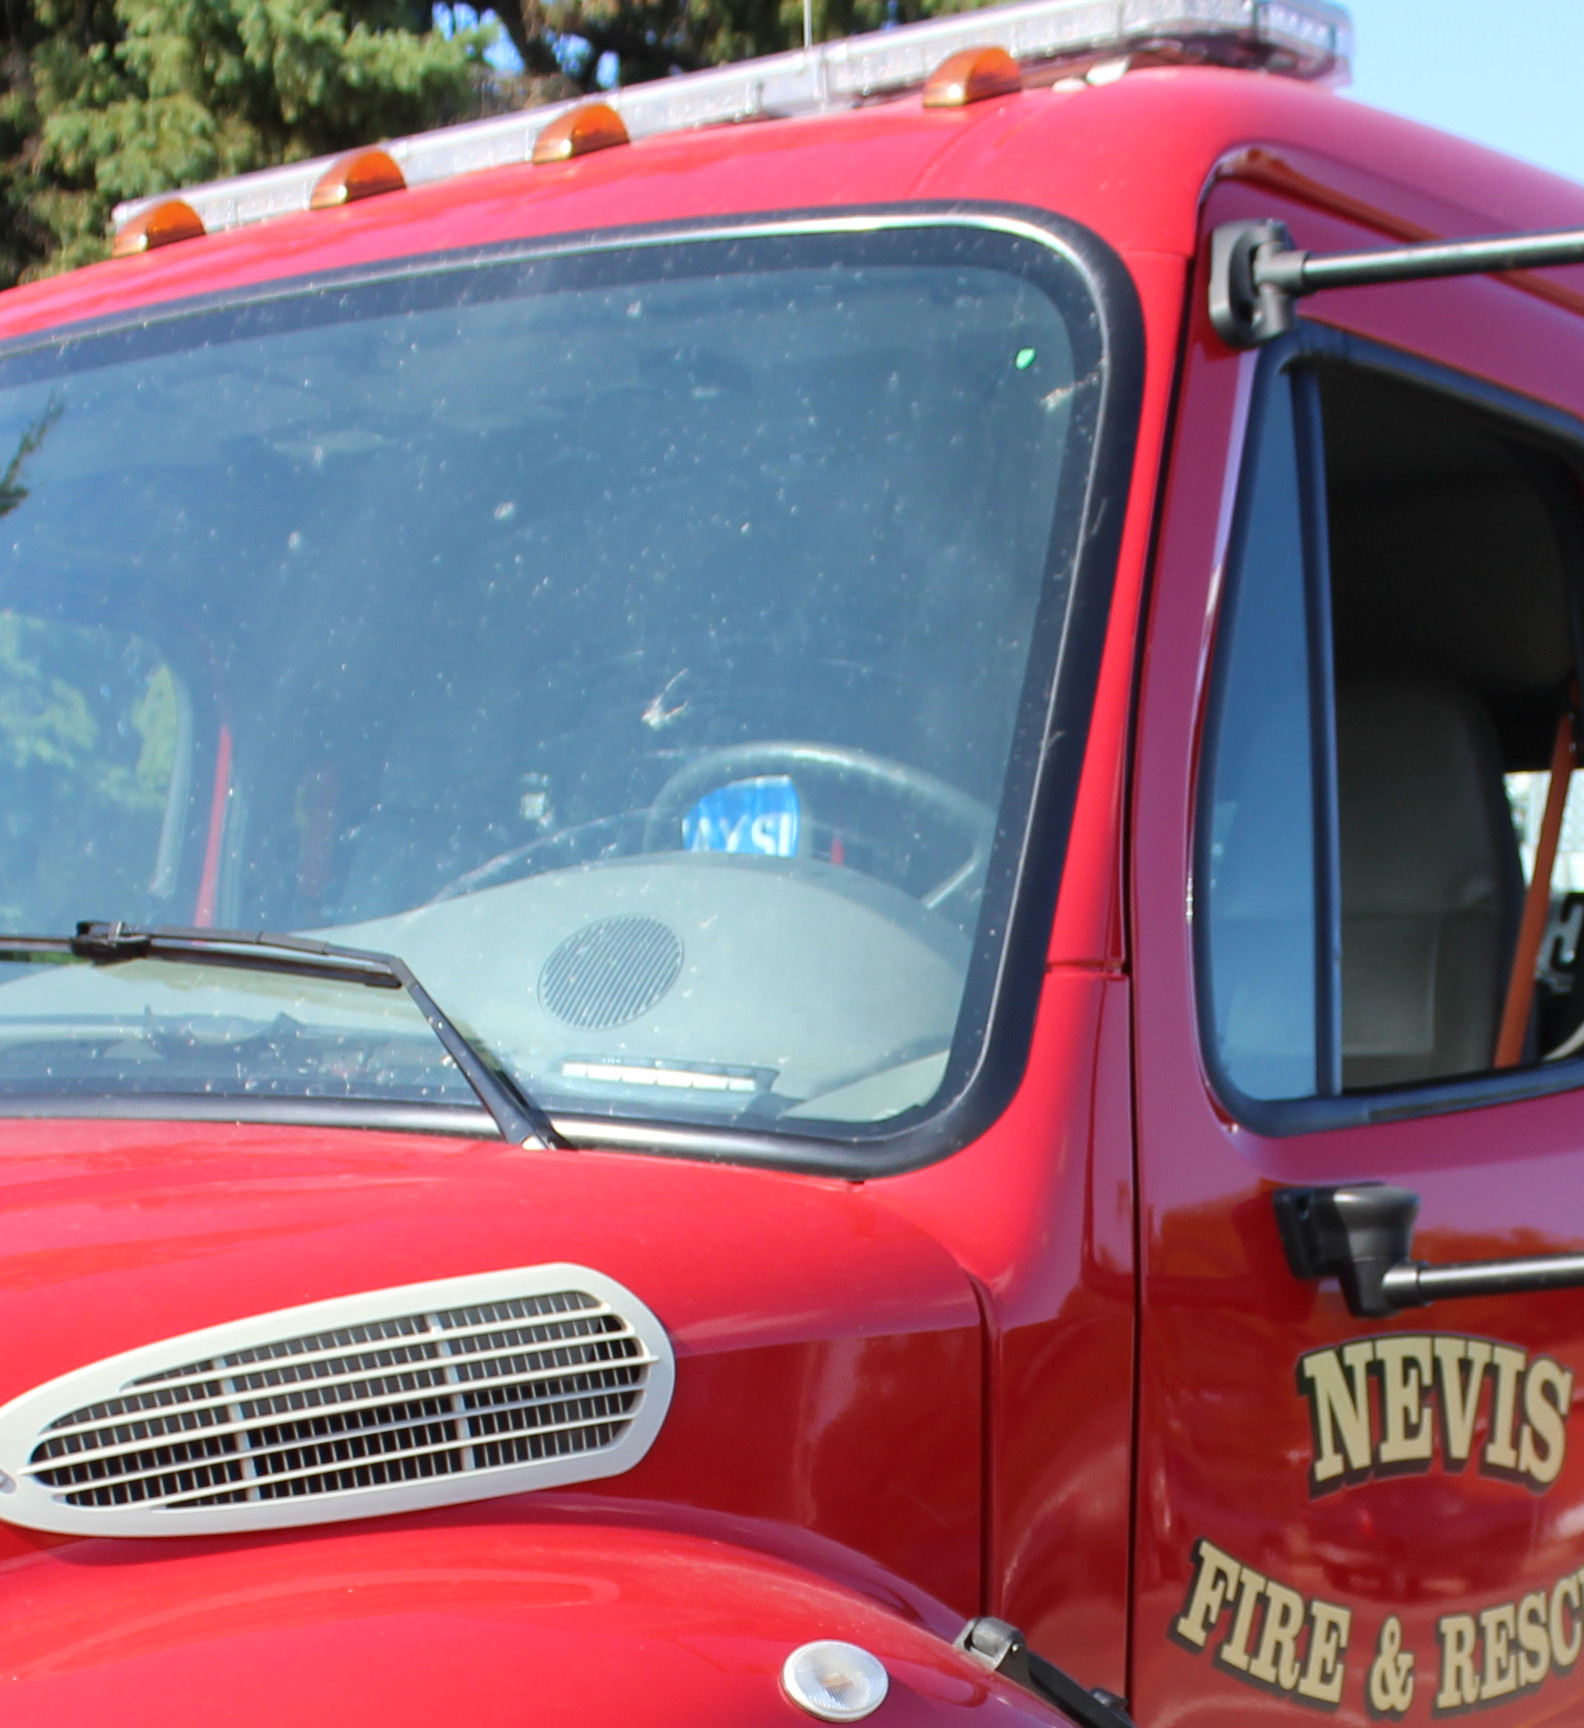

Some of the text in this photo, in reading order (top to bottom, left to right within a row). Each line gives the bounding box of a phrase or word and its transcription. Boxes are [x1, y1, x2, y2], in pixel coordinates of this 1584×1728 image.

[1298, 1332, 1574, 1496] NEVIS
[1169, 1538, 1352, 1711] FIRE
[1366, 1615, 1414, 1720] &
